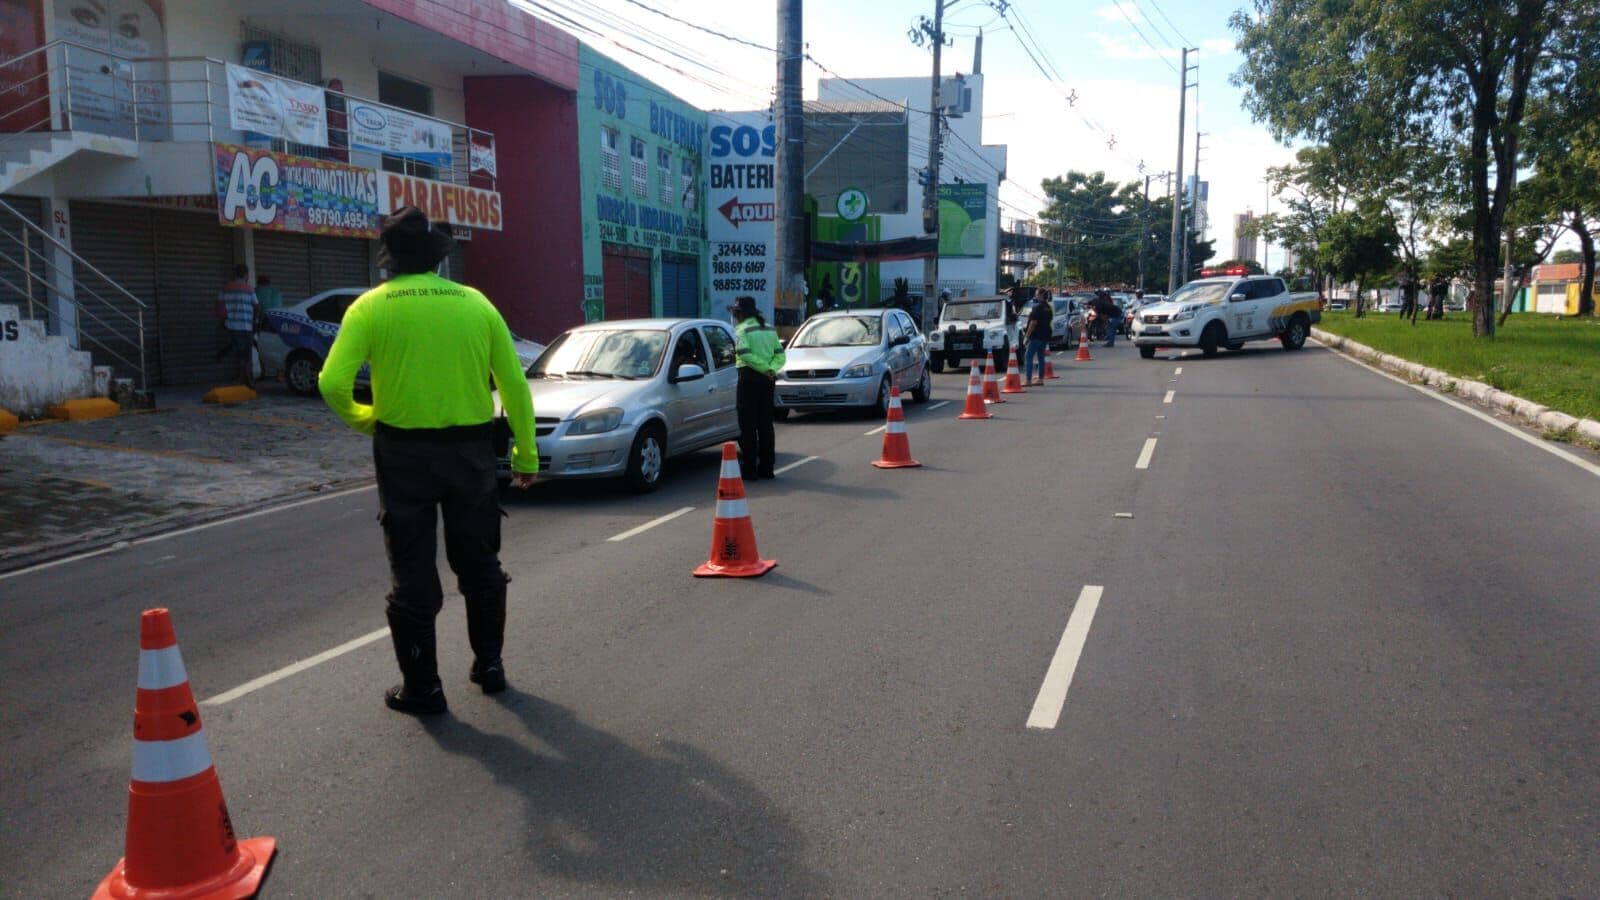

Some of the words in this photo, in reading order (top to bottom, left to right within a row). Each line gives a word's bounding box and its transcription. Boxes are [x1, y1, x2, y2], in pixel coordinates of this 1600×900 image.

[593, 67, 625, 120] SOS
[649, 100, 703, 155] BATERIAS
[710, 125, 776, 158] SOS
[303, 167, 376, 204] AUTOMOTIVAS
[387, 174, 500, 228] PARAFUSOS
[730, 203, 774, 221] AQUI
[386, 288, 417, 300] AGENTE
[418, 288, 430, 296] DE
